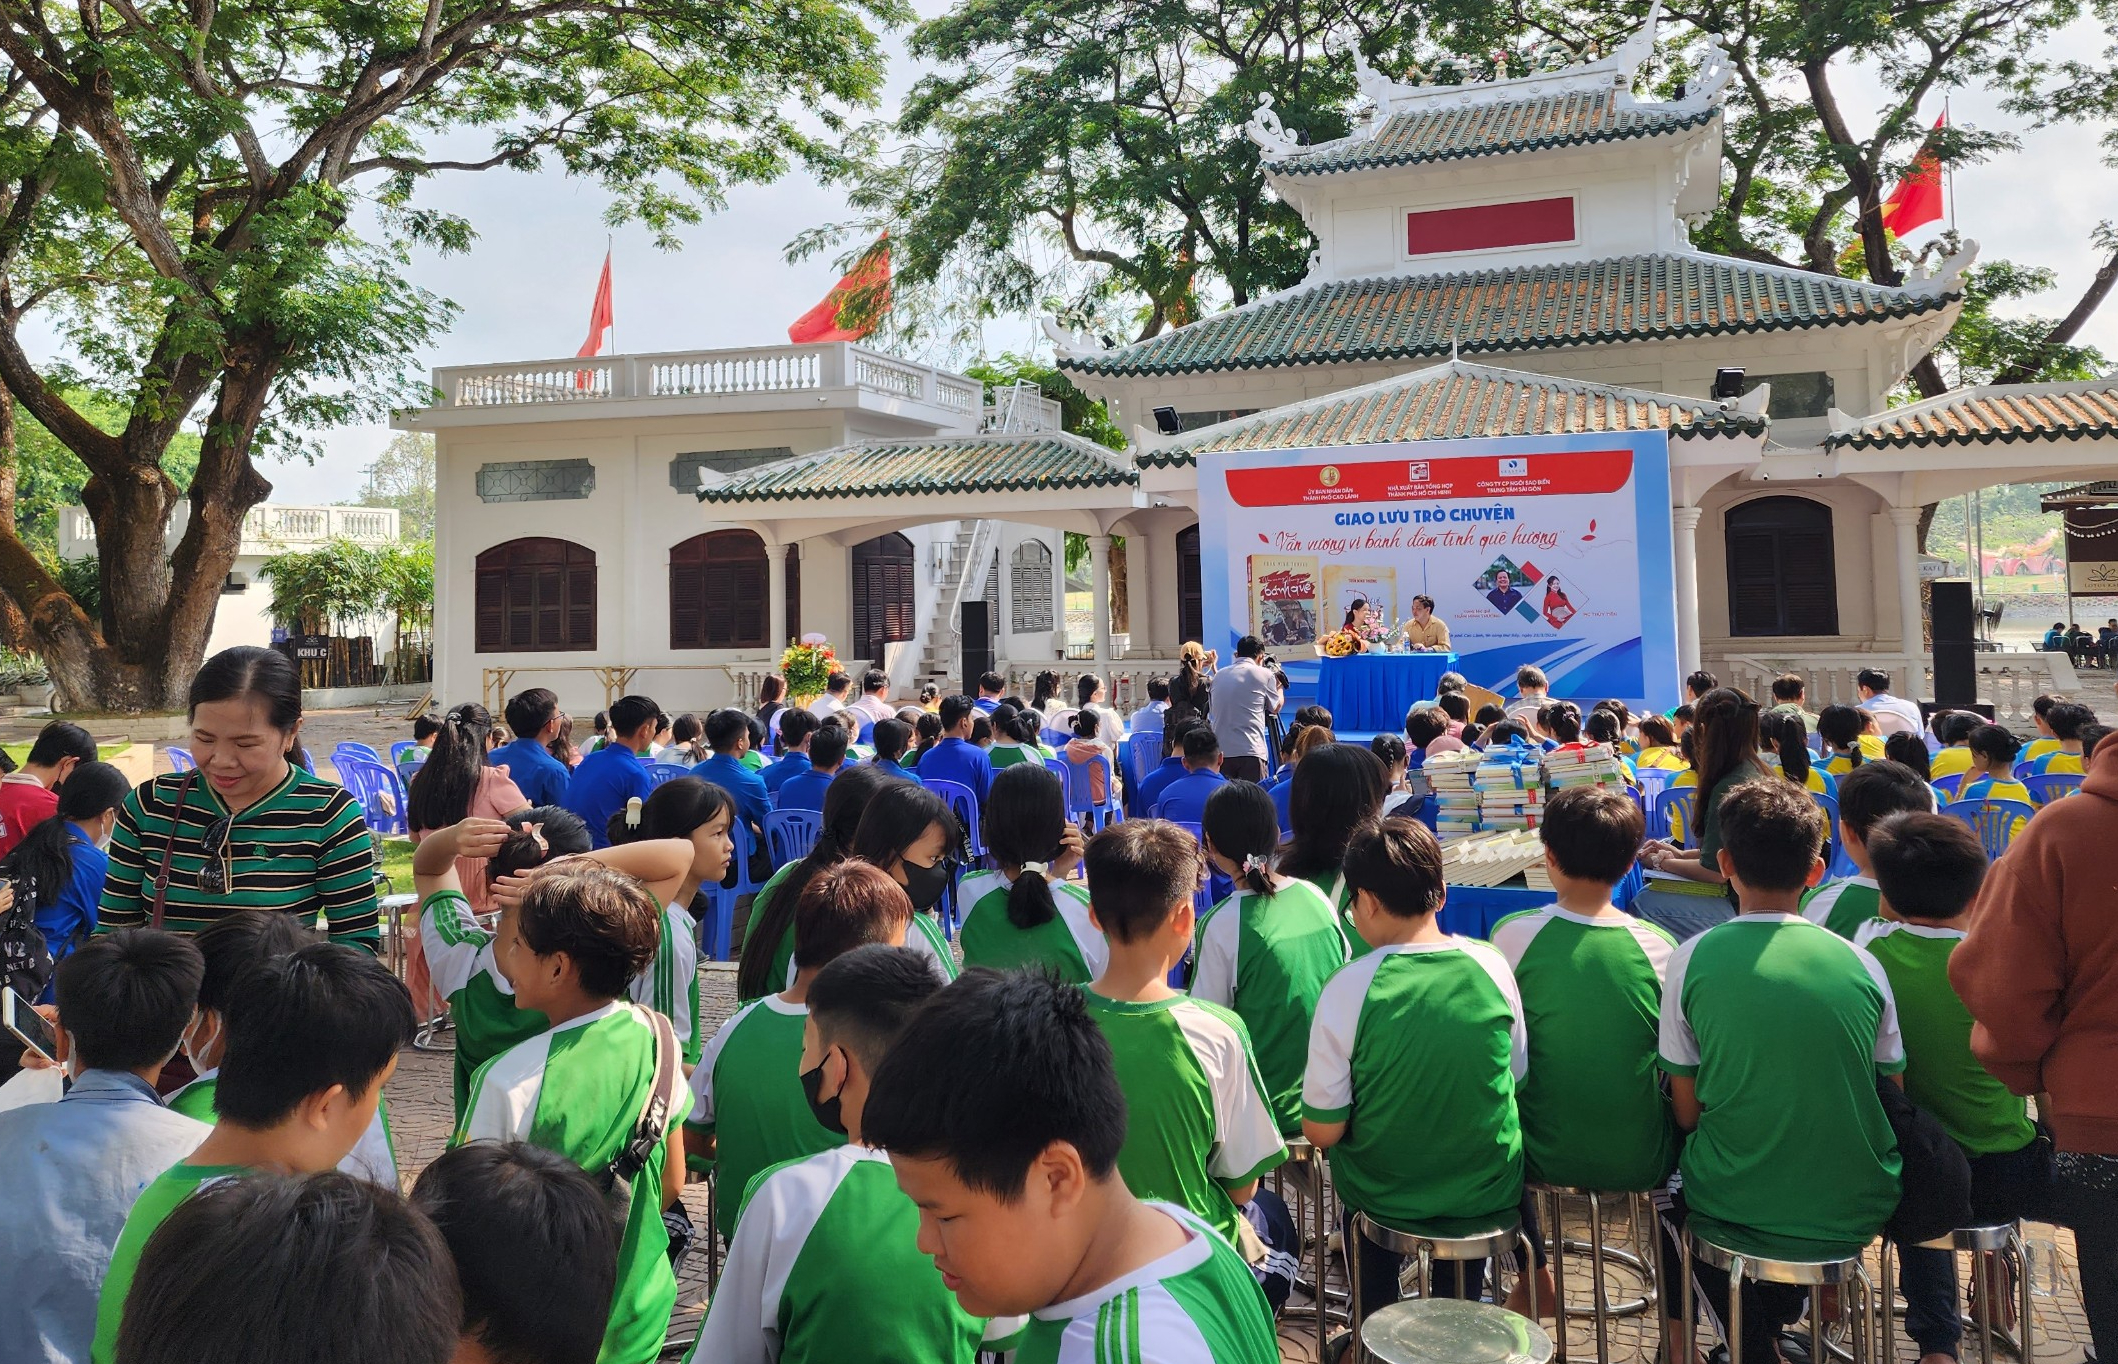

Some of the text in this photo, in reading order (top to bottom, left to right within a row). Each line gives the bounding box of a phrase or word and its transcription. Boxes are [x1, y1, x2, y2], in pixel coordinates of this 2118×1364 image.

[1334, 503, 1516, 526] GIAO LƯU TRÒ CHUYỆN
[1479, 531, 1509, 555] quê
[297, 648, 327, 657] KHU C
